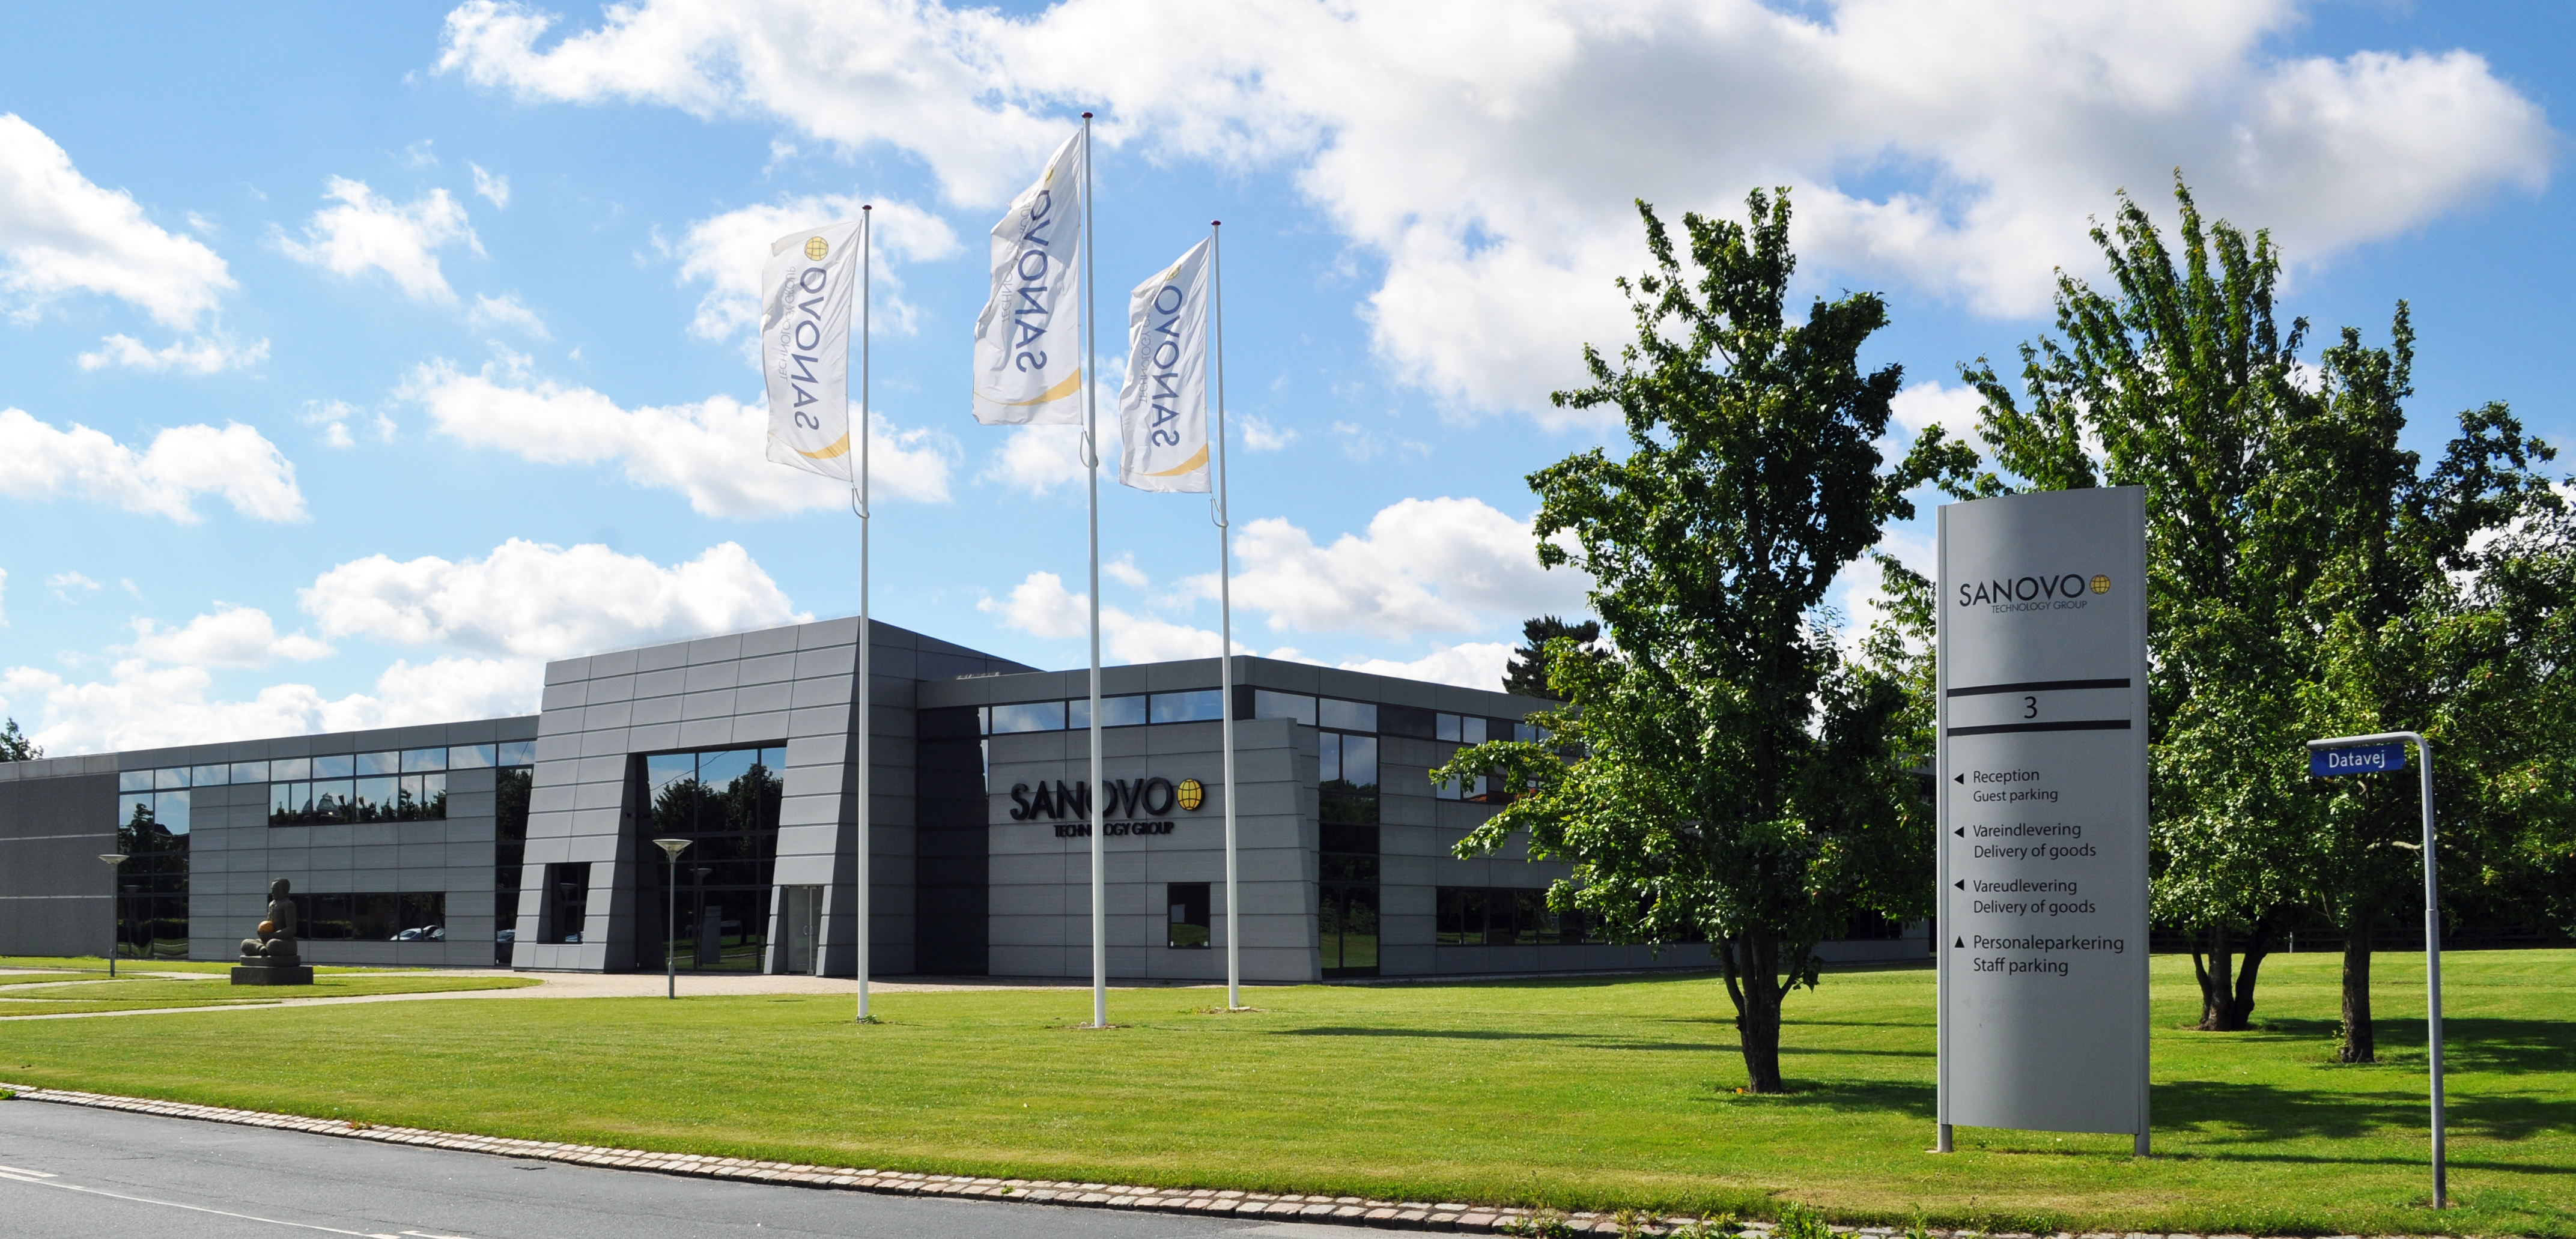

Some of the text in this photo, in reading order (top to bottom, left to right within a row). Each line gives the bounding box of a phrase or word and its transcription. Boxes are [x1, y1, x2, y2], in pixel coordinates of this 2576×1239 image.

[1959, 574, 2085, 607] SANOVO
[1991, 600, 2088, 613] TECHNOLOGY GROUP
[2023, 695, 2038, 719] 3
[2328, 750, 2385, 769] Datavej
[1973, 769, 2040, 785] Reception
[1010, 777, 1174, 820] SANOVO
[1973, 789, 2058, 804] Guest parking
[1053, 822, 1174, 837] TECHNOGY GROUP
[1973, 823, 2082, 838] Vareindlevering
[1974, 843, 2096, 860] Delivery of goods
[1973, 879, 2077, 895] Vareudlevering
[1973, 900, 2096, 916] Delivery of goods
[1973, 935, 2124, 954] Personaleparkering
[1973, 957, 2068, 977] Staff parking
